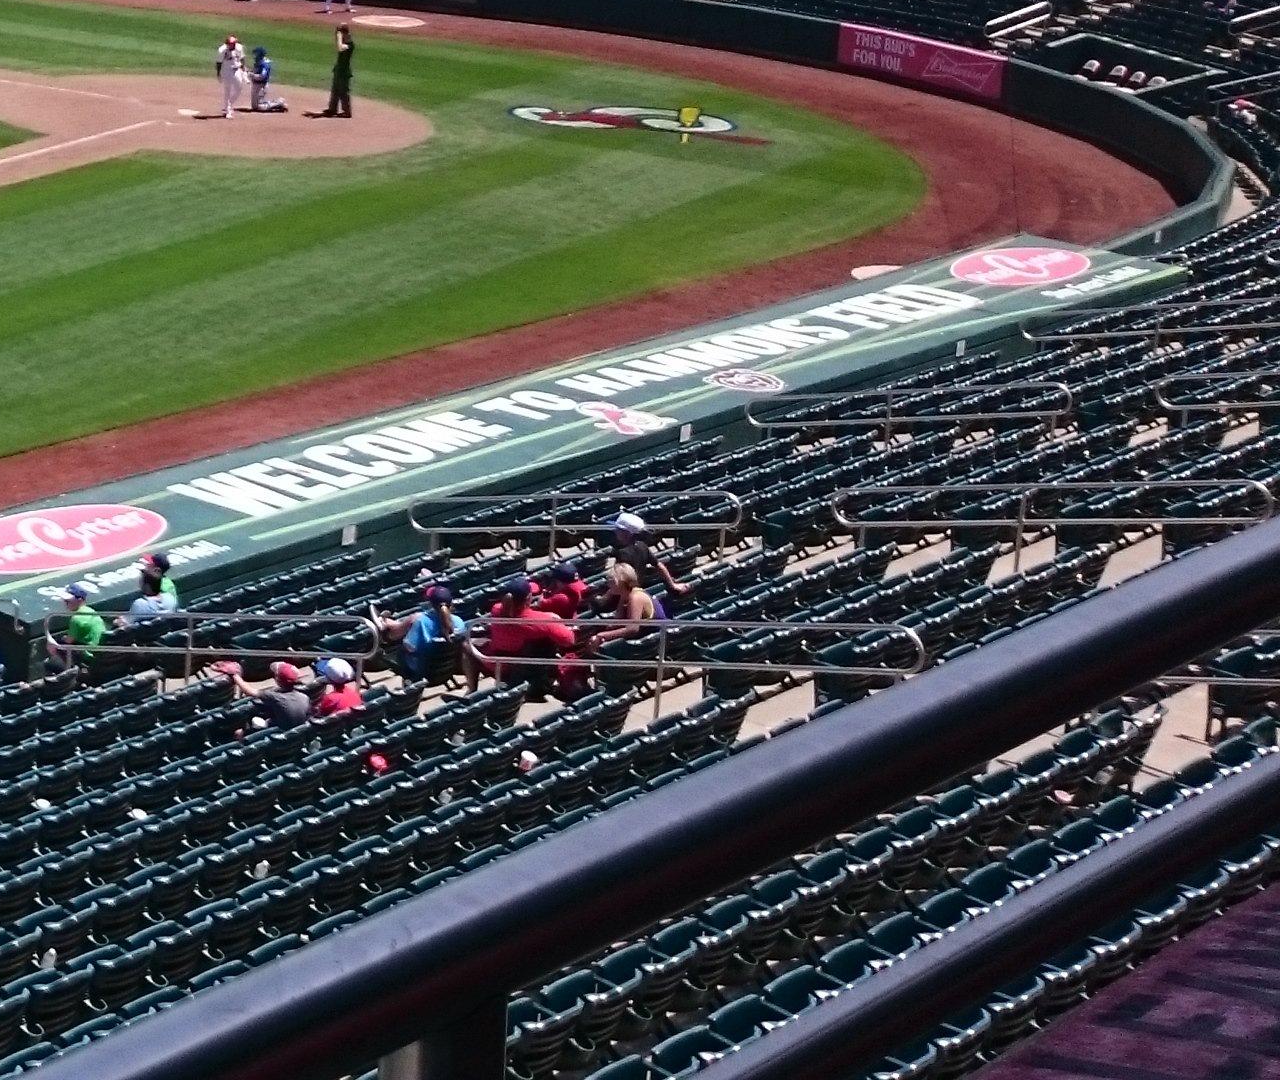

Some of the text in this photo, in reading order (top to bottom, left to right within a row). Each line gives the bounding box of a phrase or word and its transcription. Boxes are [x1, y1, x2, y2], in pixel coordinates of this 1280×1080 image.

[853, 48, 877, 65] FOR
[855, 32, 916, 57] THIS BUD'S
[167, 284, 985, 518] WELCOME TO HAMMONS FIELD
